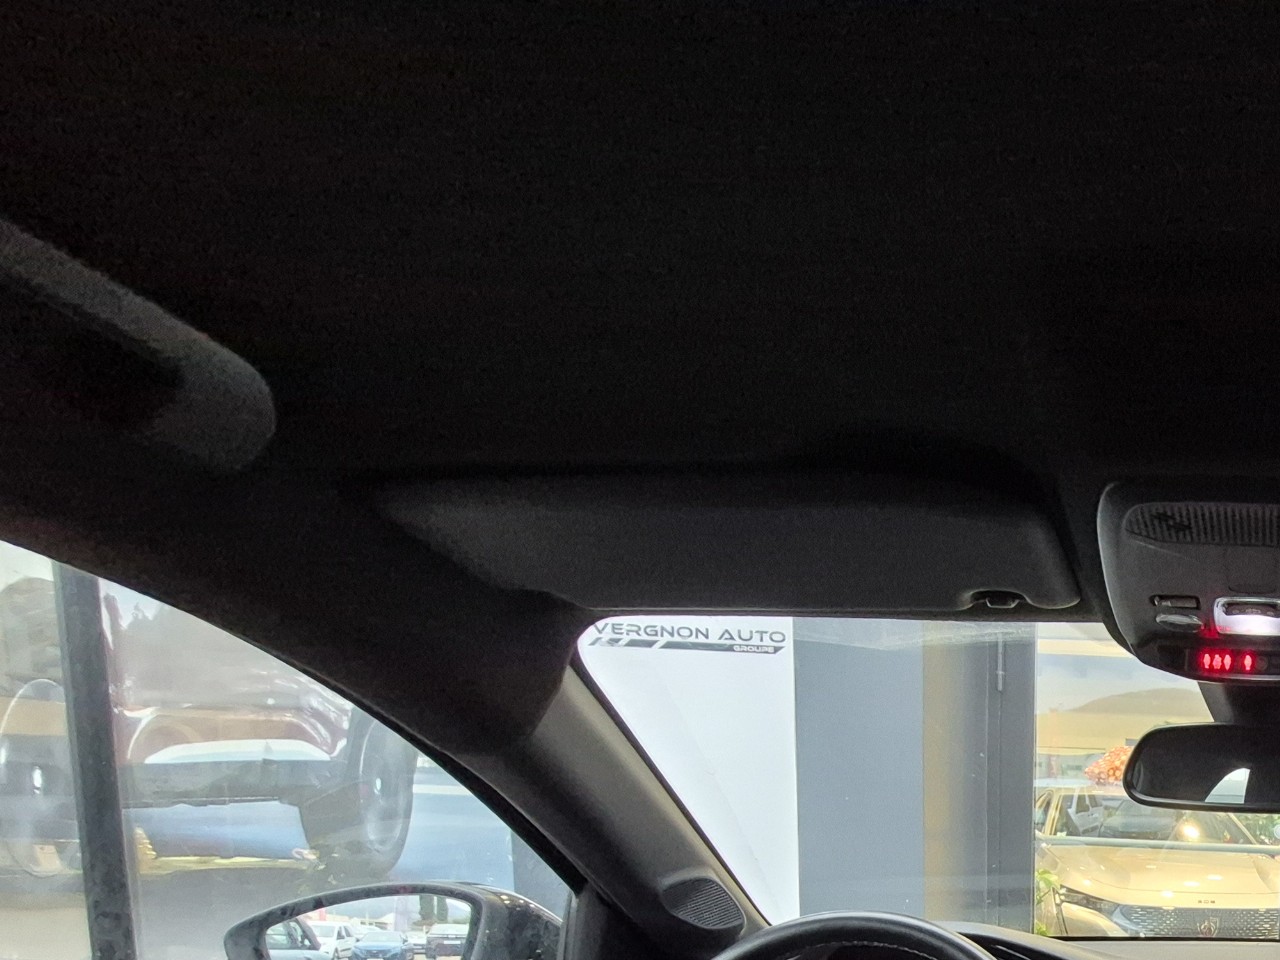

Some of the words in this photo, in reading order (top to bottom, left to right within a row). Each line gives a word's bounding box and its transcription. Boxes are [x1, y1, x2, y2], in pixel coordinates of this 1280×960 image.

[593, 622, 710, 640] VERGNON
[717, 628, 787, 643] AUTO
[732, 644, 776, 654] GROUPE
